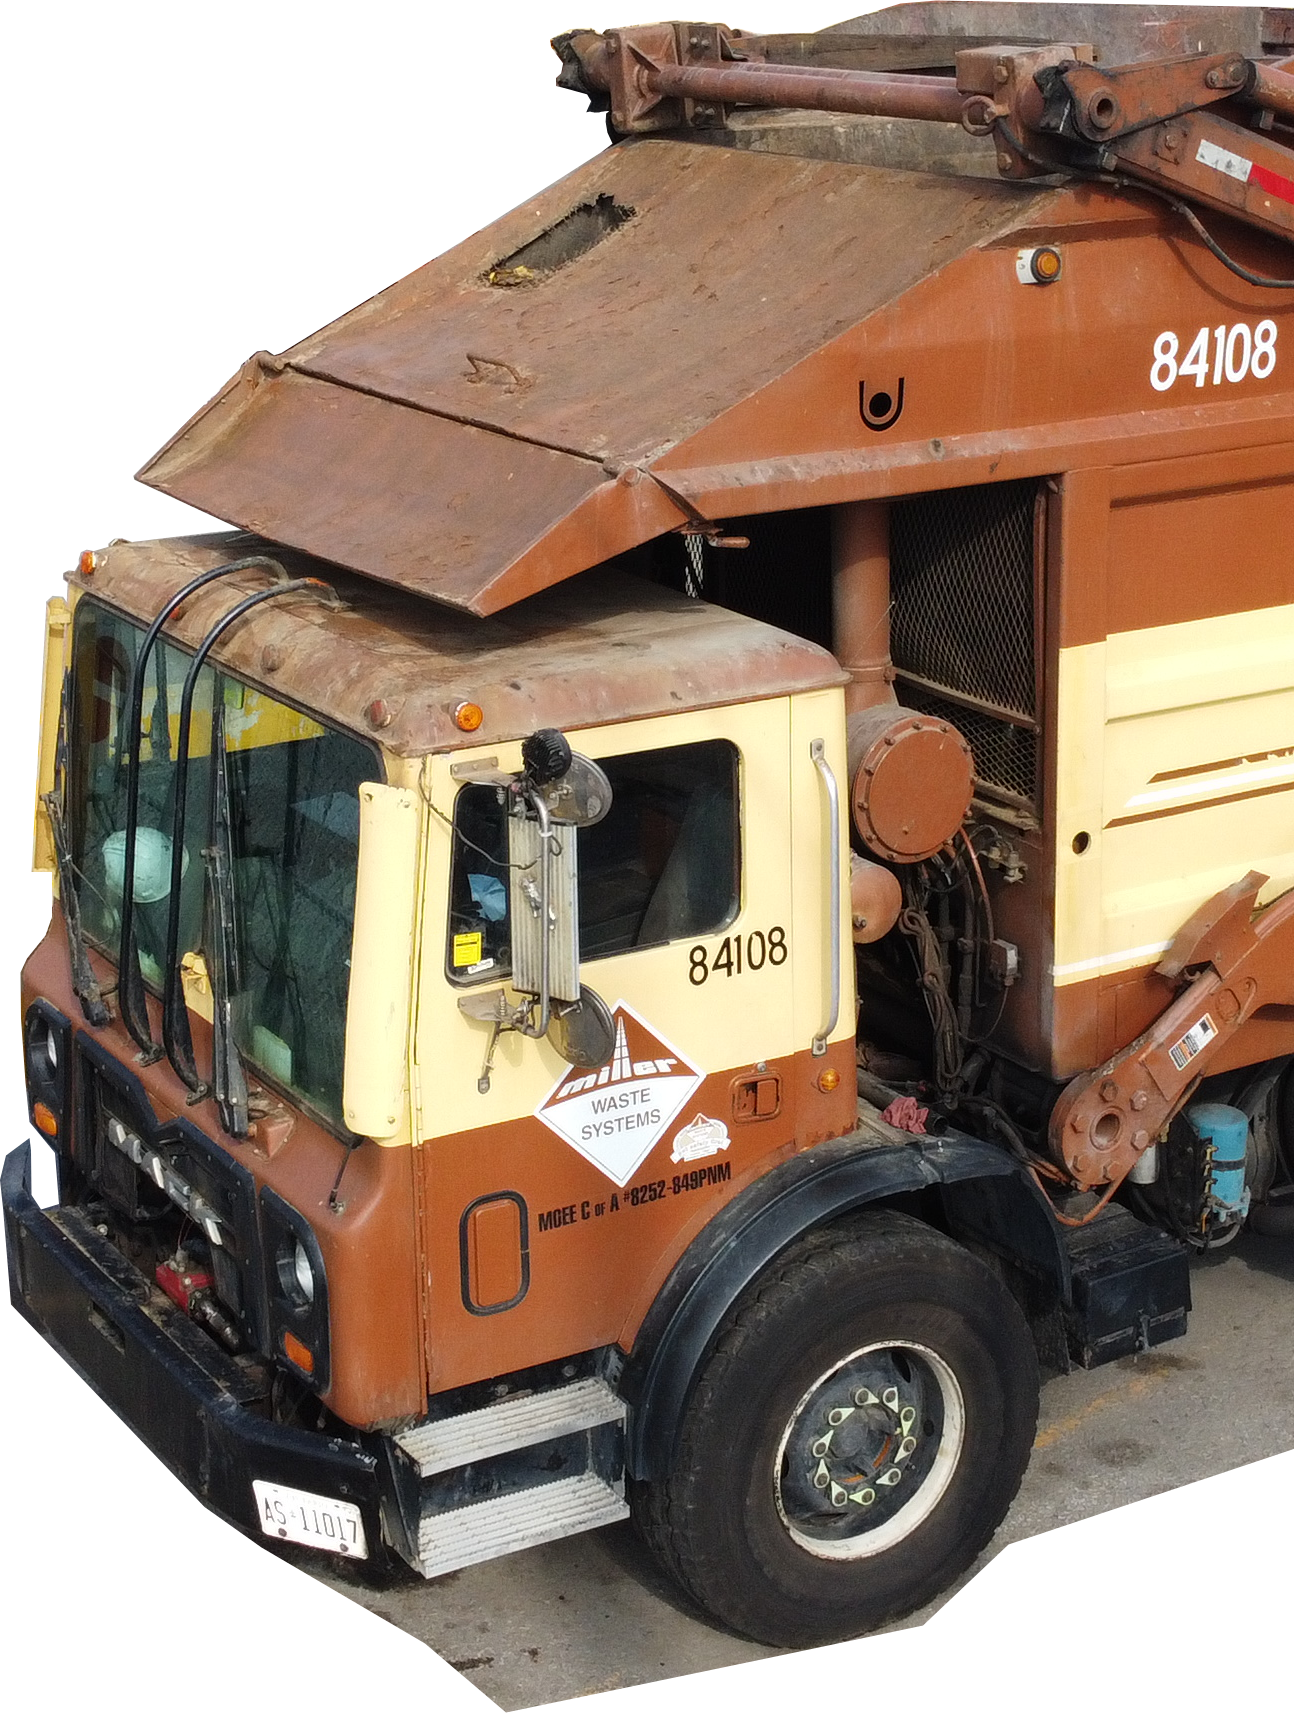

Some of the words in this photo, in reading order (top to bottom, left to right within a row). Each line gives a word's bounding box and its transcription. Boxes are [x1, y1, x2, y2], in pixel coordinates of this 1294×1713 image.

[1150, 319, 1278, 392] 84108
[689, 926, 788, 986] 84108
[591, 1087, 651, 1115] WASTE
[581, 1108, 661, 1141] SYSTEMS
[581, 1200, 591, 1220] C
[609, 1192, 620, 1213] A
[264, 1497, 287, 1525] AS
[300, 1506, 357, 1544] 11017
